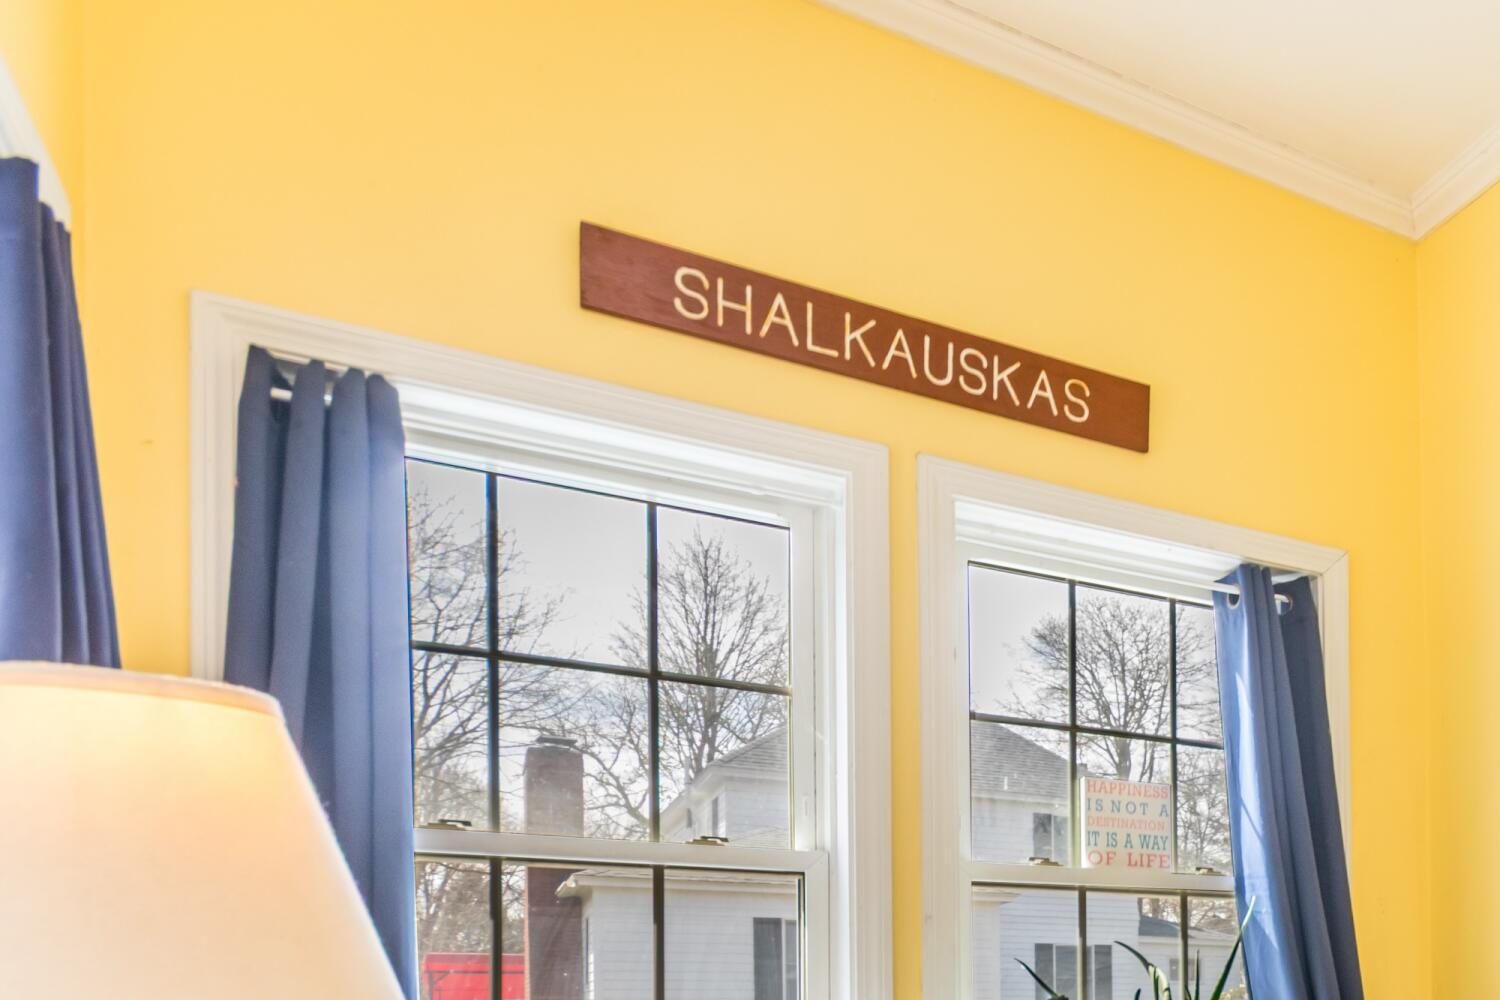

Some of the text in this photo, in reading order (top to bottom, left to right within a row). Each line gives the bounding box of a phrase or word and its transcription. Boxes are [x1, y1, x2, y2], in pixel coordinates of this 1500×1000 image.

[673, 266, 1091, 423] SHALKAUSKAS
[1087, 779, 1169, 800] HAPPINESS
[1087, 797, 1169, 817] IS NOT A
[1087, 830, 1169, 851] IT IS A WAY
[1087, 849, 1170, 869] OF LIFE
